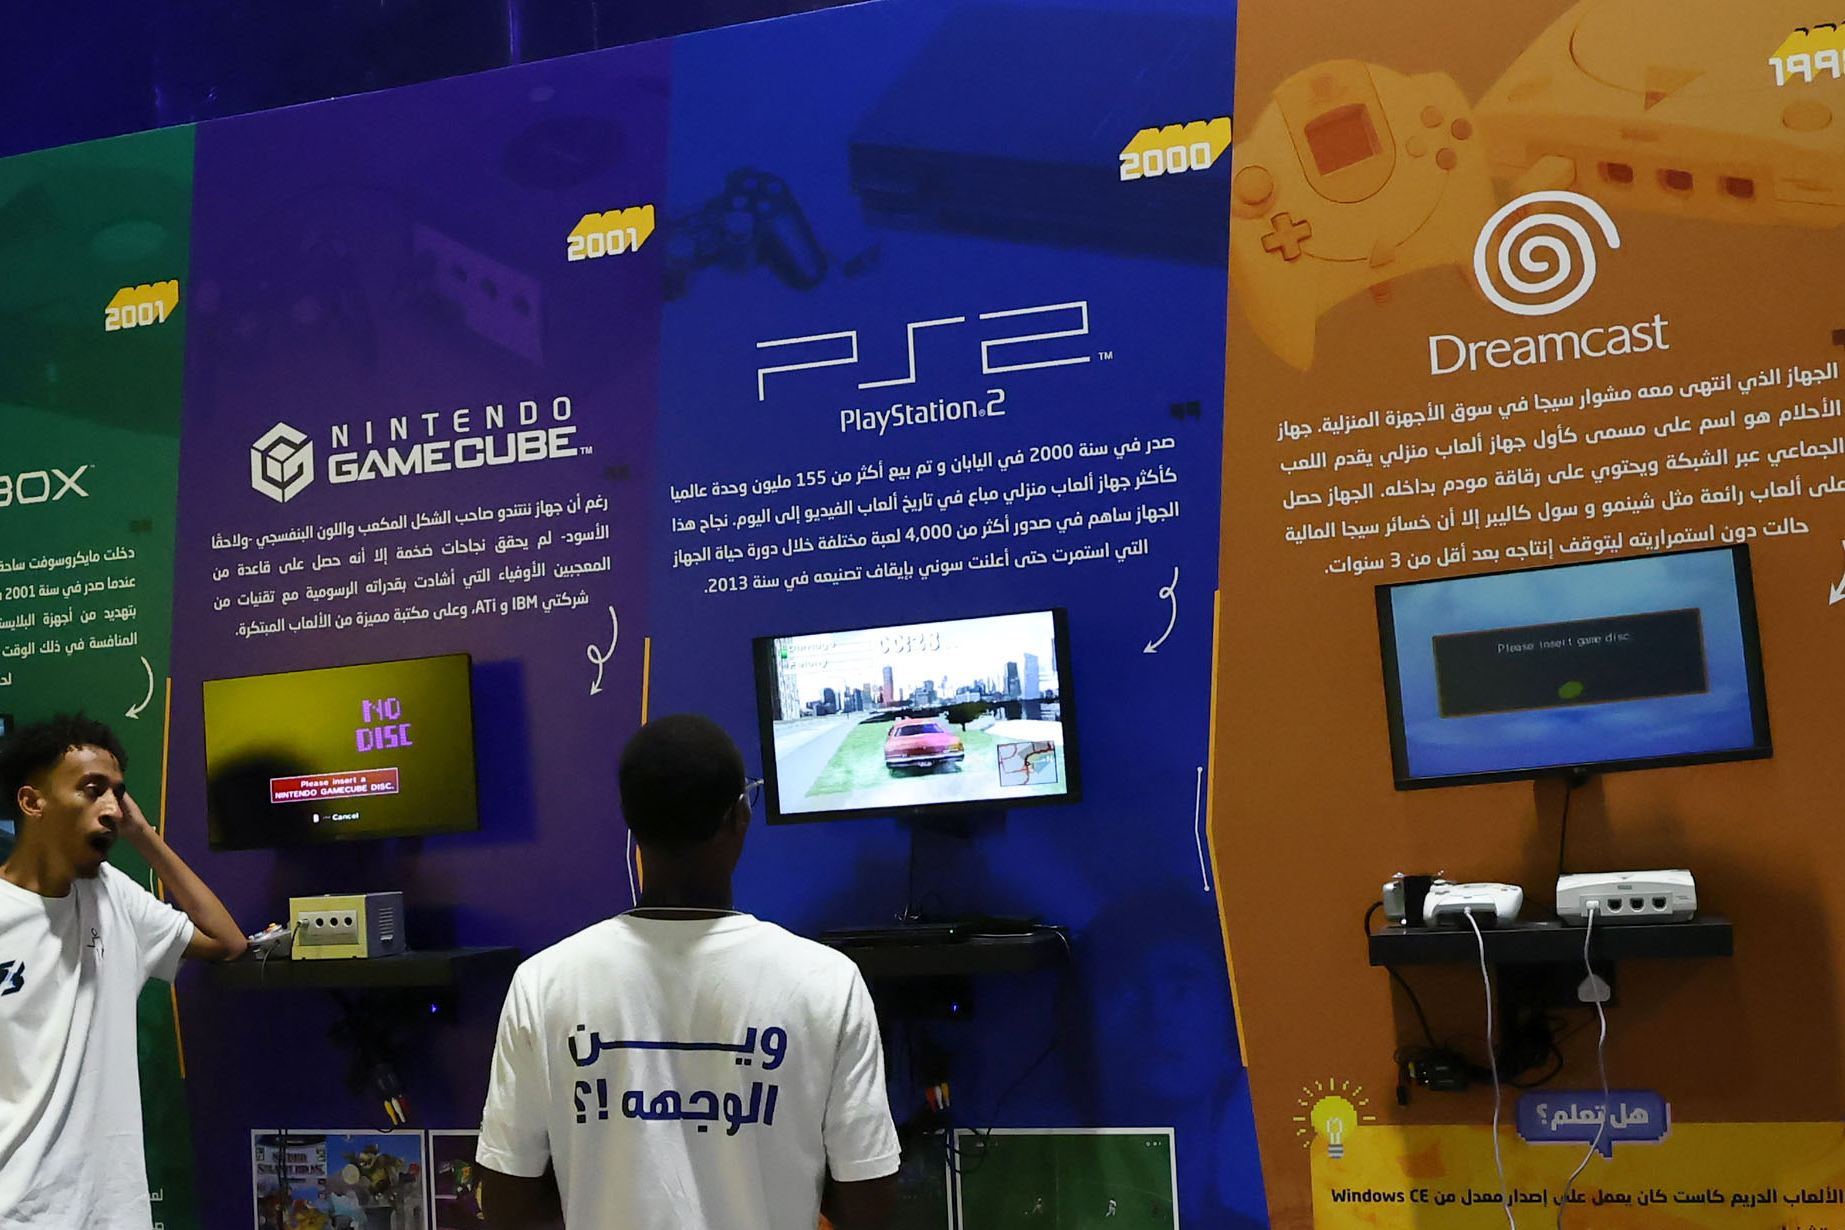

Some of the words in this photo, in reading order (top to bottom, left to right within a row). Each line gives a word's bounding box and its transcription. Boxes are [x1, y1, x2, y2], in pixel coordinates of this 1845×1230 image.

[1768, 48, 1845, 87] 199
[1118, 141, 1212, 182] 2000
[566, 226, 640, 262] 2001
[104, 300, 165, 332] 2001
[756, 300, 1091, 402] PS2
[1427, 313, 1671, 376] Dreamcast
[1737, 366, 1780, 395] الذي
[1786, 360, 1838, 388] الجهاز
[1637, 384, 1673, 399] معه
[1679, 372, 1731, 398] انتهى
[1533, 392, 1573, 413] سيجا
[1578, 384, 1631, 410] مشوار
[1385, 400, 1444, 430] الأجهزة
[1450, 401, 1492, 423] سوق
[1498, 396, 1528, 420] في
[331, 396, 573, 448] NINTENDO
[1276, 419, 1312, 442] جهاز
[1317, 410, 1379, 435] المنزلية.
[1029, 442, 1073, 463] 2000
[1078, 442, 1108, 457] سنة
[1113, 436, 1140, 460] في
[1145, 437, 1174, 454] صدر
[915, 459, 932, 479] تم
[936, 460, 945, 477] و
[950, 450, 992, 473] اليابان
[997, 448, 1024, 472] في
[796, 469, 826, 487] 155
[831, 470, 851, 486] من
[855, 459, 883, 485] أكثر
[888, 465, 910, 482] بيع
[670, 482, 707, 503] عالميا
[711, 481, 747, 497] وحدة
[751, 473, 791, 495] مليون
[1629, 523, 1714, 550] استمراريته
[1720, 525, 1756, 544] دون
[1762, 516, 1809, 536] حالت
[1051, 541, 1109, 565] استمرت
[1114, 537, 1148, 563] التي
[1505, 537, 1553, 561] إنتاجه
[1559, 531, 1622, 555] ليتوقف
[967, 546, 1009, 569] أعلنت
[1014, 549, 1047, 569] حتى
[1390, 550, 1400, 569] 3
[1407, 552, 1431, 570] من
[1436, 541, 1466, 567] أقل
[1472, 548, 1499, 563] بعد
[813, 565, 862, 585] تصنيعه
[865, 559, 913, 580] بإيقاف
[918, 558, 963, 580] سوني
[1324, 555, 1384, 576] سنوات.
[38, 583, 59, 597] سنة
[61, 580, 81, 600] في
[83, 580, 104, 596] صدر
[106, 575, 135, 590] عندما
[704, 574, 747, 594] 2013.
[752, 574, 779, 589] سنة
[783, 570, 808, 592] في
[4, 584, 35, 600] 2001
[512, 593, 537, 611] IBM
[541, 589, 588, 614] شركتي
[393, 604, 429, 623] مكتبة
[432, 601, 467, 620] وعلى
[499, 601, 508, 615] و
[235, 617, 284, 639] المبتكرة.
[288, 610, 331, 633] الألعاب
[334, 613, 352, 630] من
[355, 610, 389, 628] مميزة
[1497, 642, 1534, 655] Please
[1539, 637, 1573, 649] insert
[1577, 635, 1601, 647] game
[361, 696, 402, 723] NO
[354, 723, 414, 753] DISC
[274, 788, 317, 800] NINTENDO
[320, 785, 368, 796] GAMECUBE
[300, 778, 329, 788] Please
[331, 776, 357, 786] insert
[331, 811, 360, 822] Cancel
[621, 1081, 779, 1137] الوجهه
[1534, 1101, 1607, 1130] تعلم؟
[1609, 1102, 1648, 1128] هل
